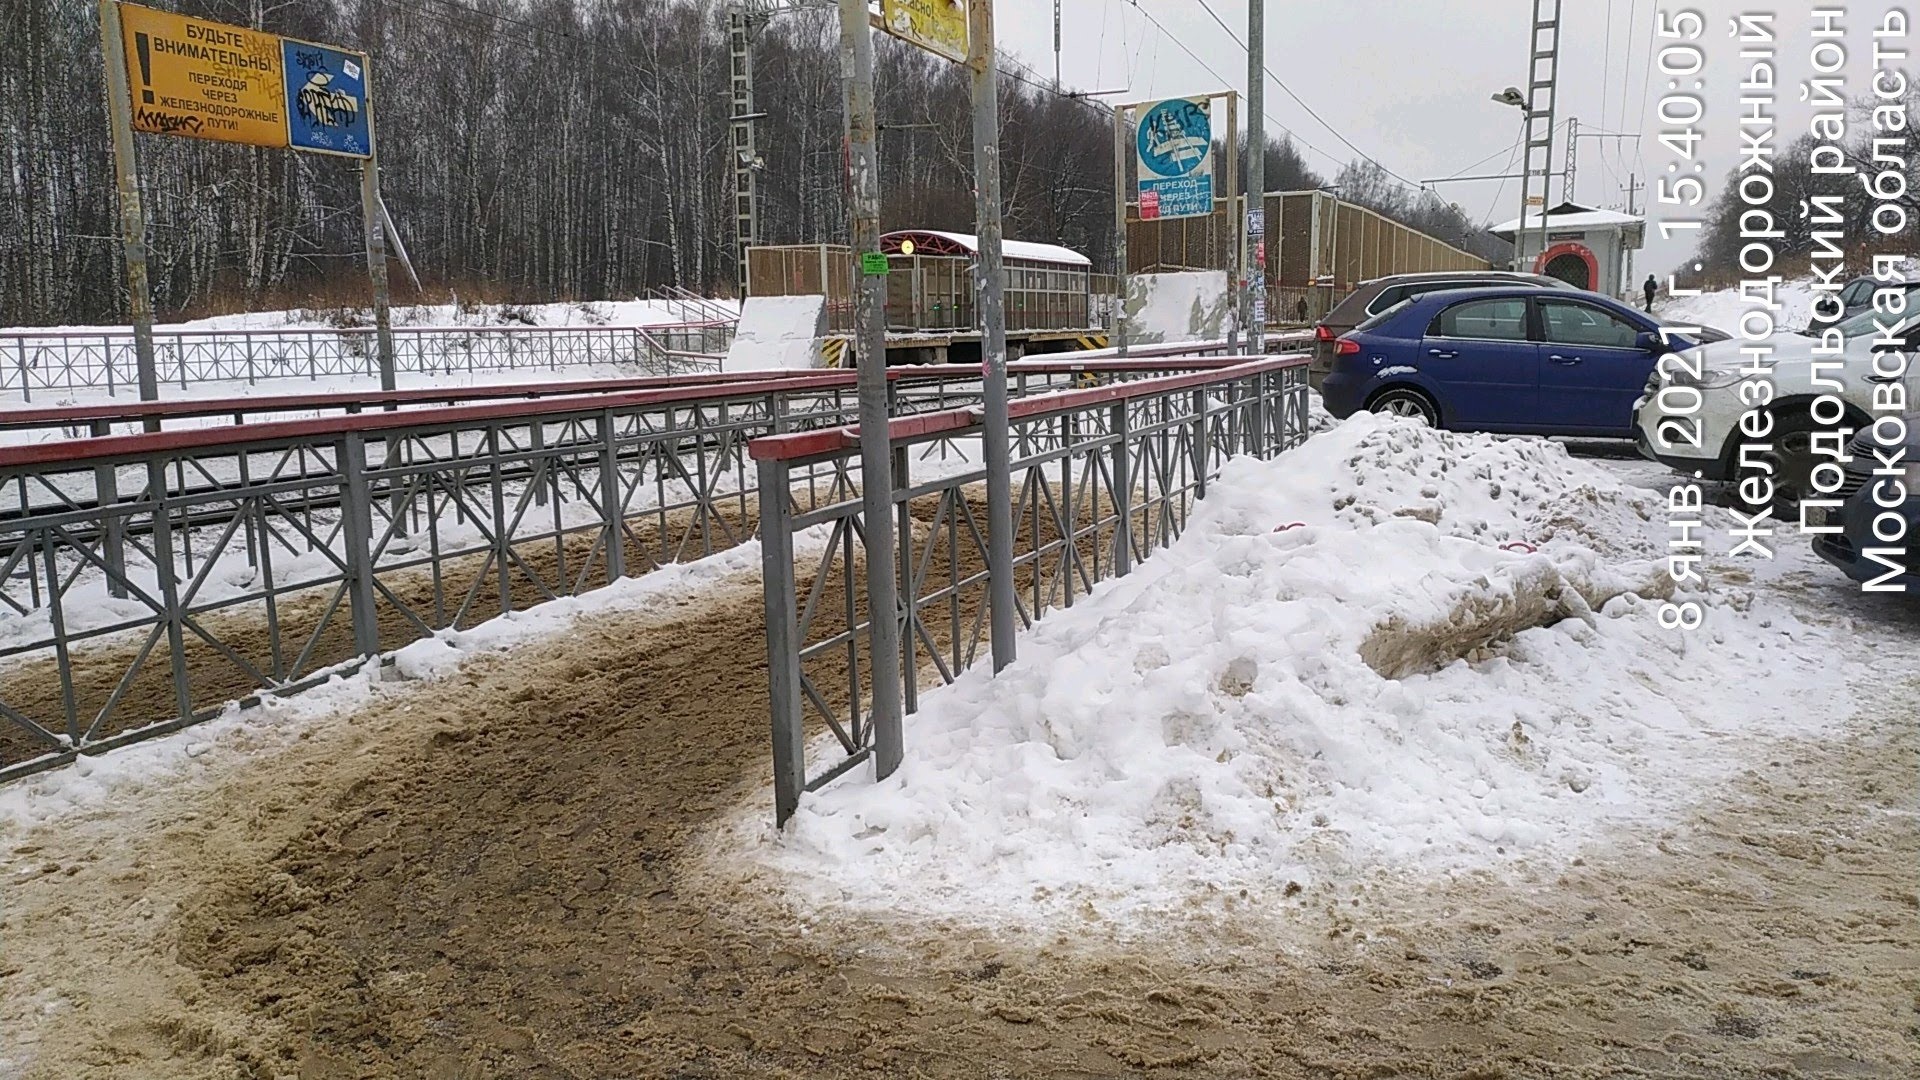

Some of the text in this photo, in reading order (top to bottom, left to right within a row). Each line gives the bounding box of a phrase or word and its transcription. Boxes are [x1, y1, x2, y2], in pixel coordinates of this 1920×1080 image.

[186, 24, 243, 48] БУДЬТЕ
[153, 37, 276, 75] ВНИМАТЕЛЬНЫ,
[188, 72, 248, 92] ПЕРЕХОДЯ
[202, 88, 238, 103] ЧЕРЕЗ
[159, 96, 279, 124] ЖЕЛЕЗНОДОРОЖНЫЕ
[207, 117, 239, 131] ПУТИ!
[1153, 180, 1197, 191] ПЕРЕХОД
[1160, 192, 1190, 202] ЧЕРЕЗ
